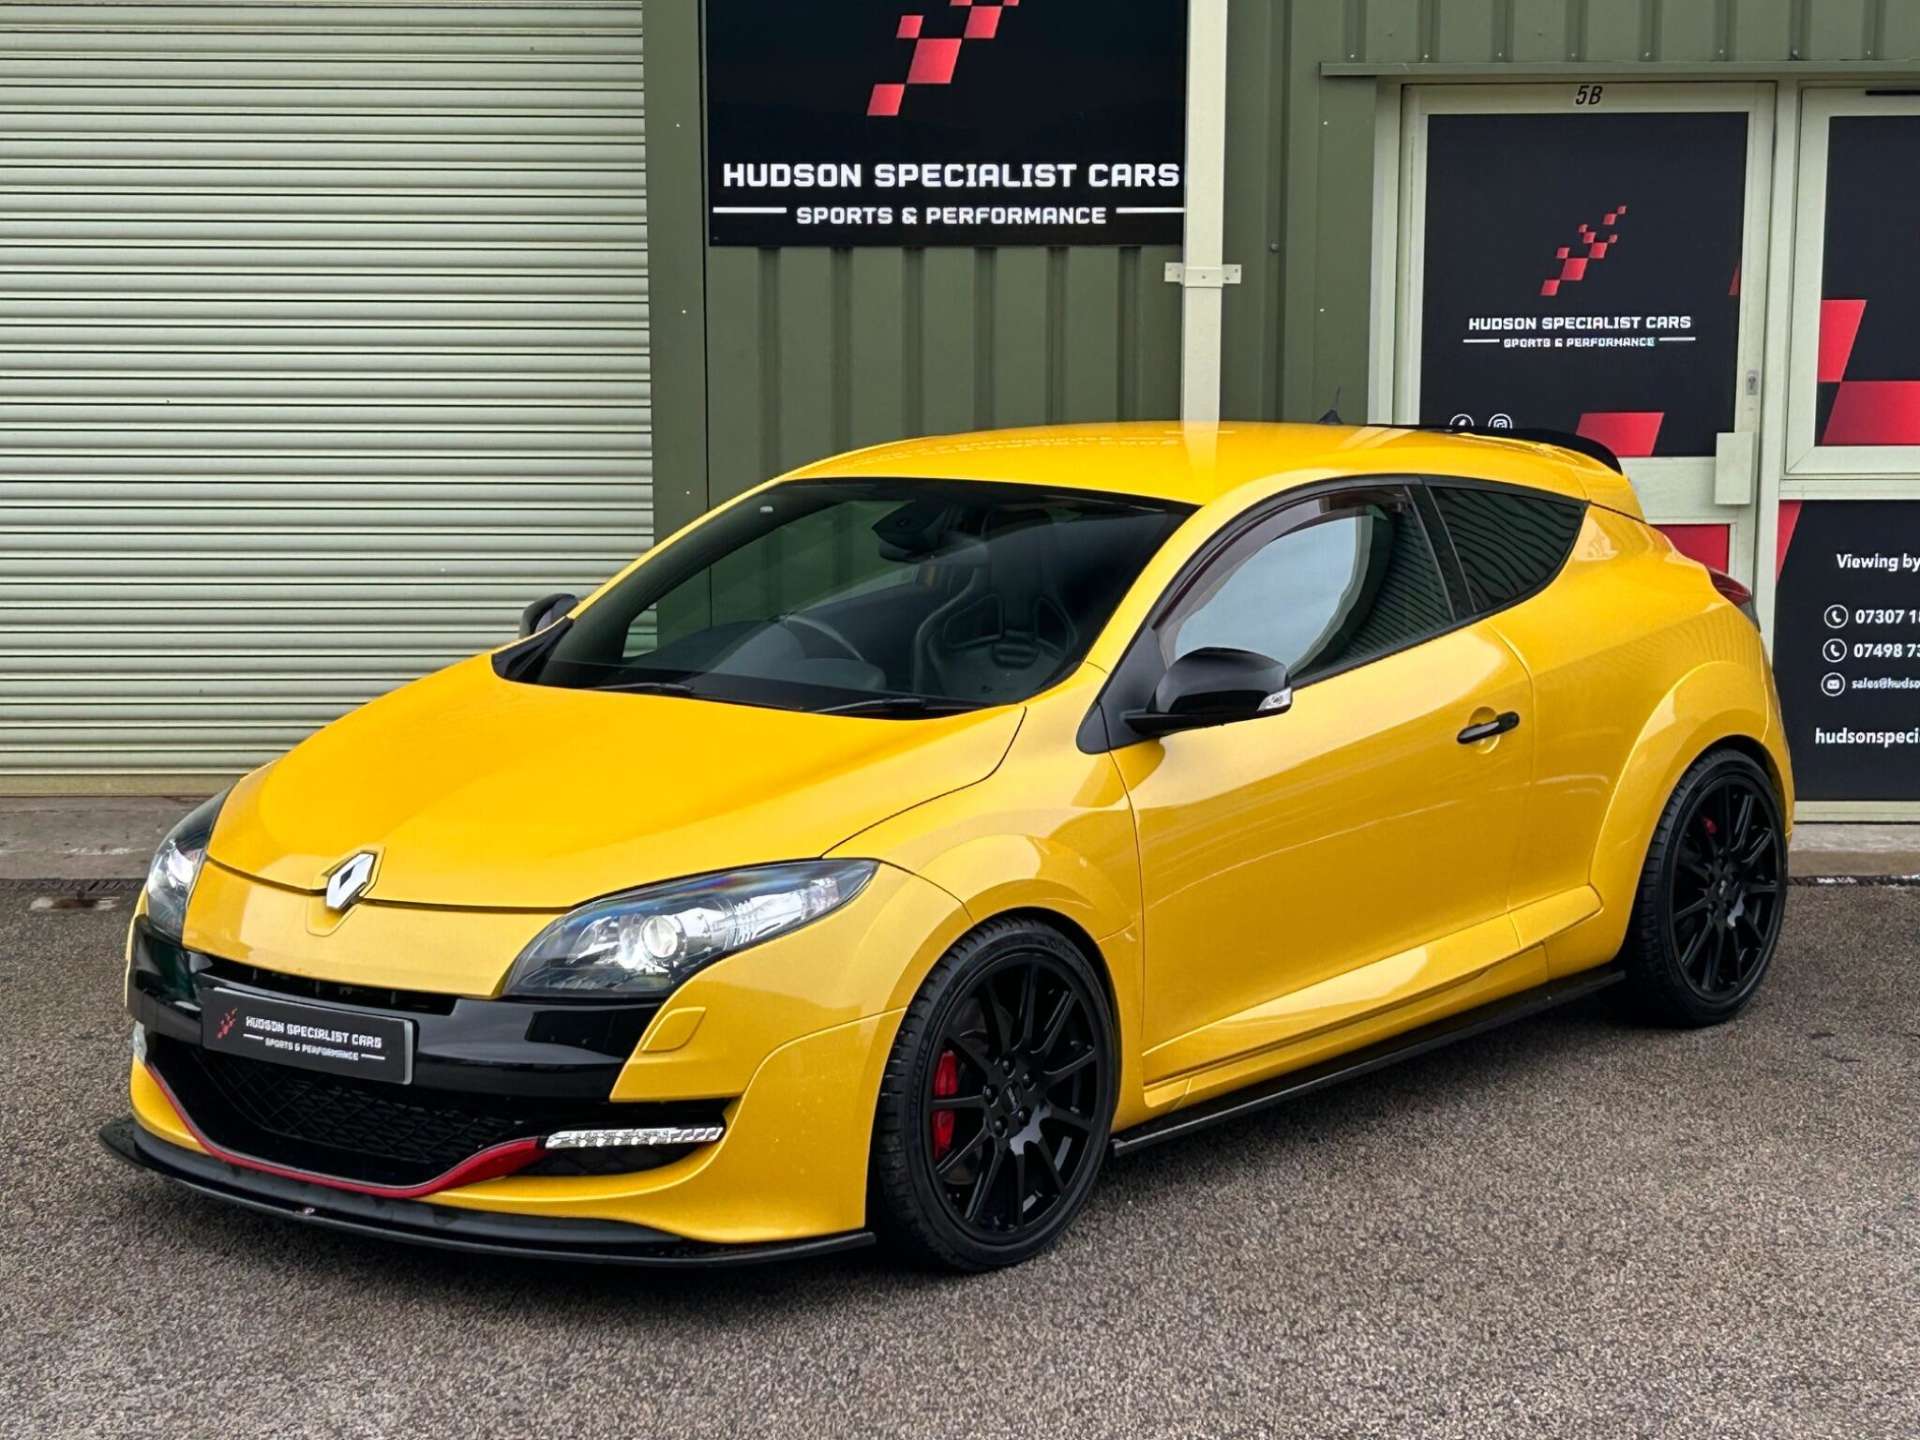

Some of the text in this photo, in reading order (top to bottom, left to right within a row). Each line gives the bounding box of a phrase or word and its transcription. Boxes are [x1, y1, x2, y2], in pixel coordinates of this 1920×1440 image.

[1575, 84, 1603, 105] 5B
[722, 163, 1180, 188] HUDSON SPECIALIST CARS
[796, 206, 1107, 225] SPORTS & PERFORMANCE
[1468, 315, 1692, 331] HUDSON SPECIALIST CARS
[1503, 337, 1655, 349] SPORTS & PERFORMANCE
[1836, 552, 1920, 573] Viewing by
[1855, 609, 1920, 625] 07307 1
[1853, 643, 1903, 658] 07498
[1815, 726, 1920, 749] hudsonspeci
[245, 1015, 383, 1049] HUDSON SPECIALIST CARS
[264, 1037, 294, 1051] SPORTS
